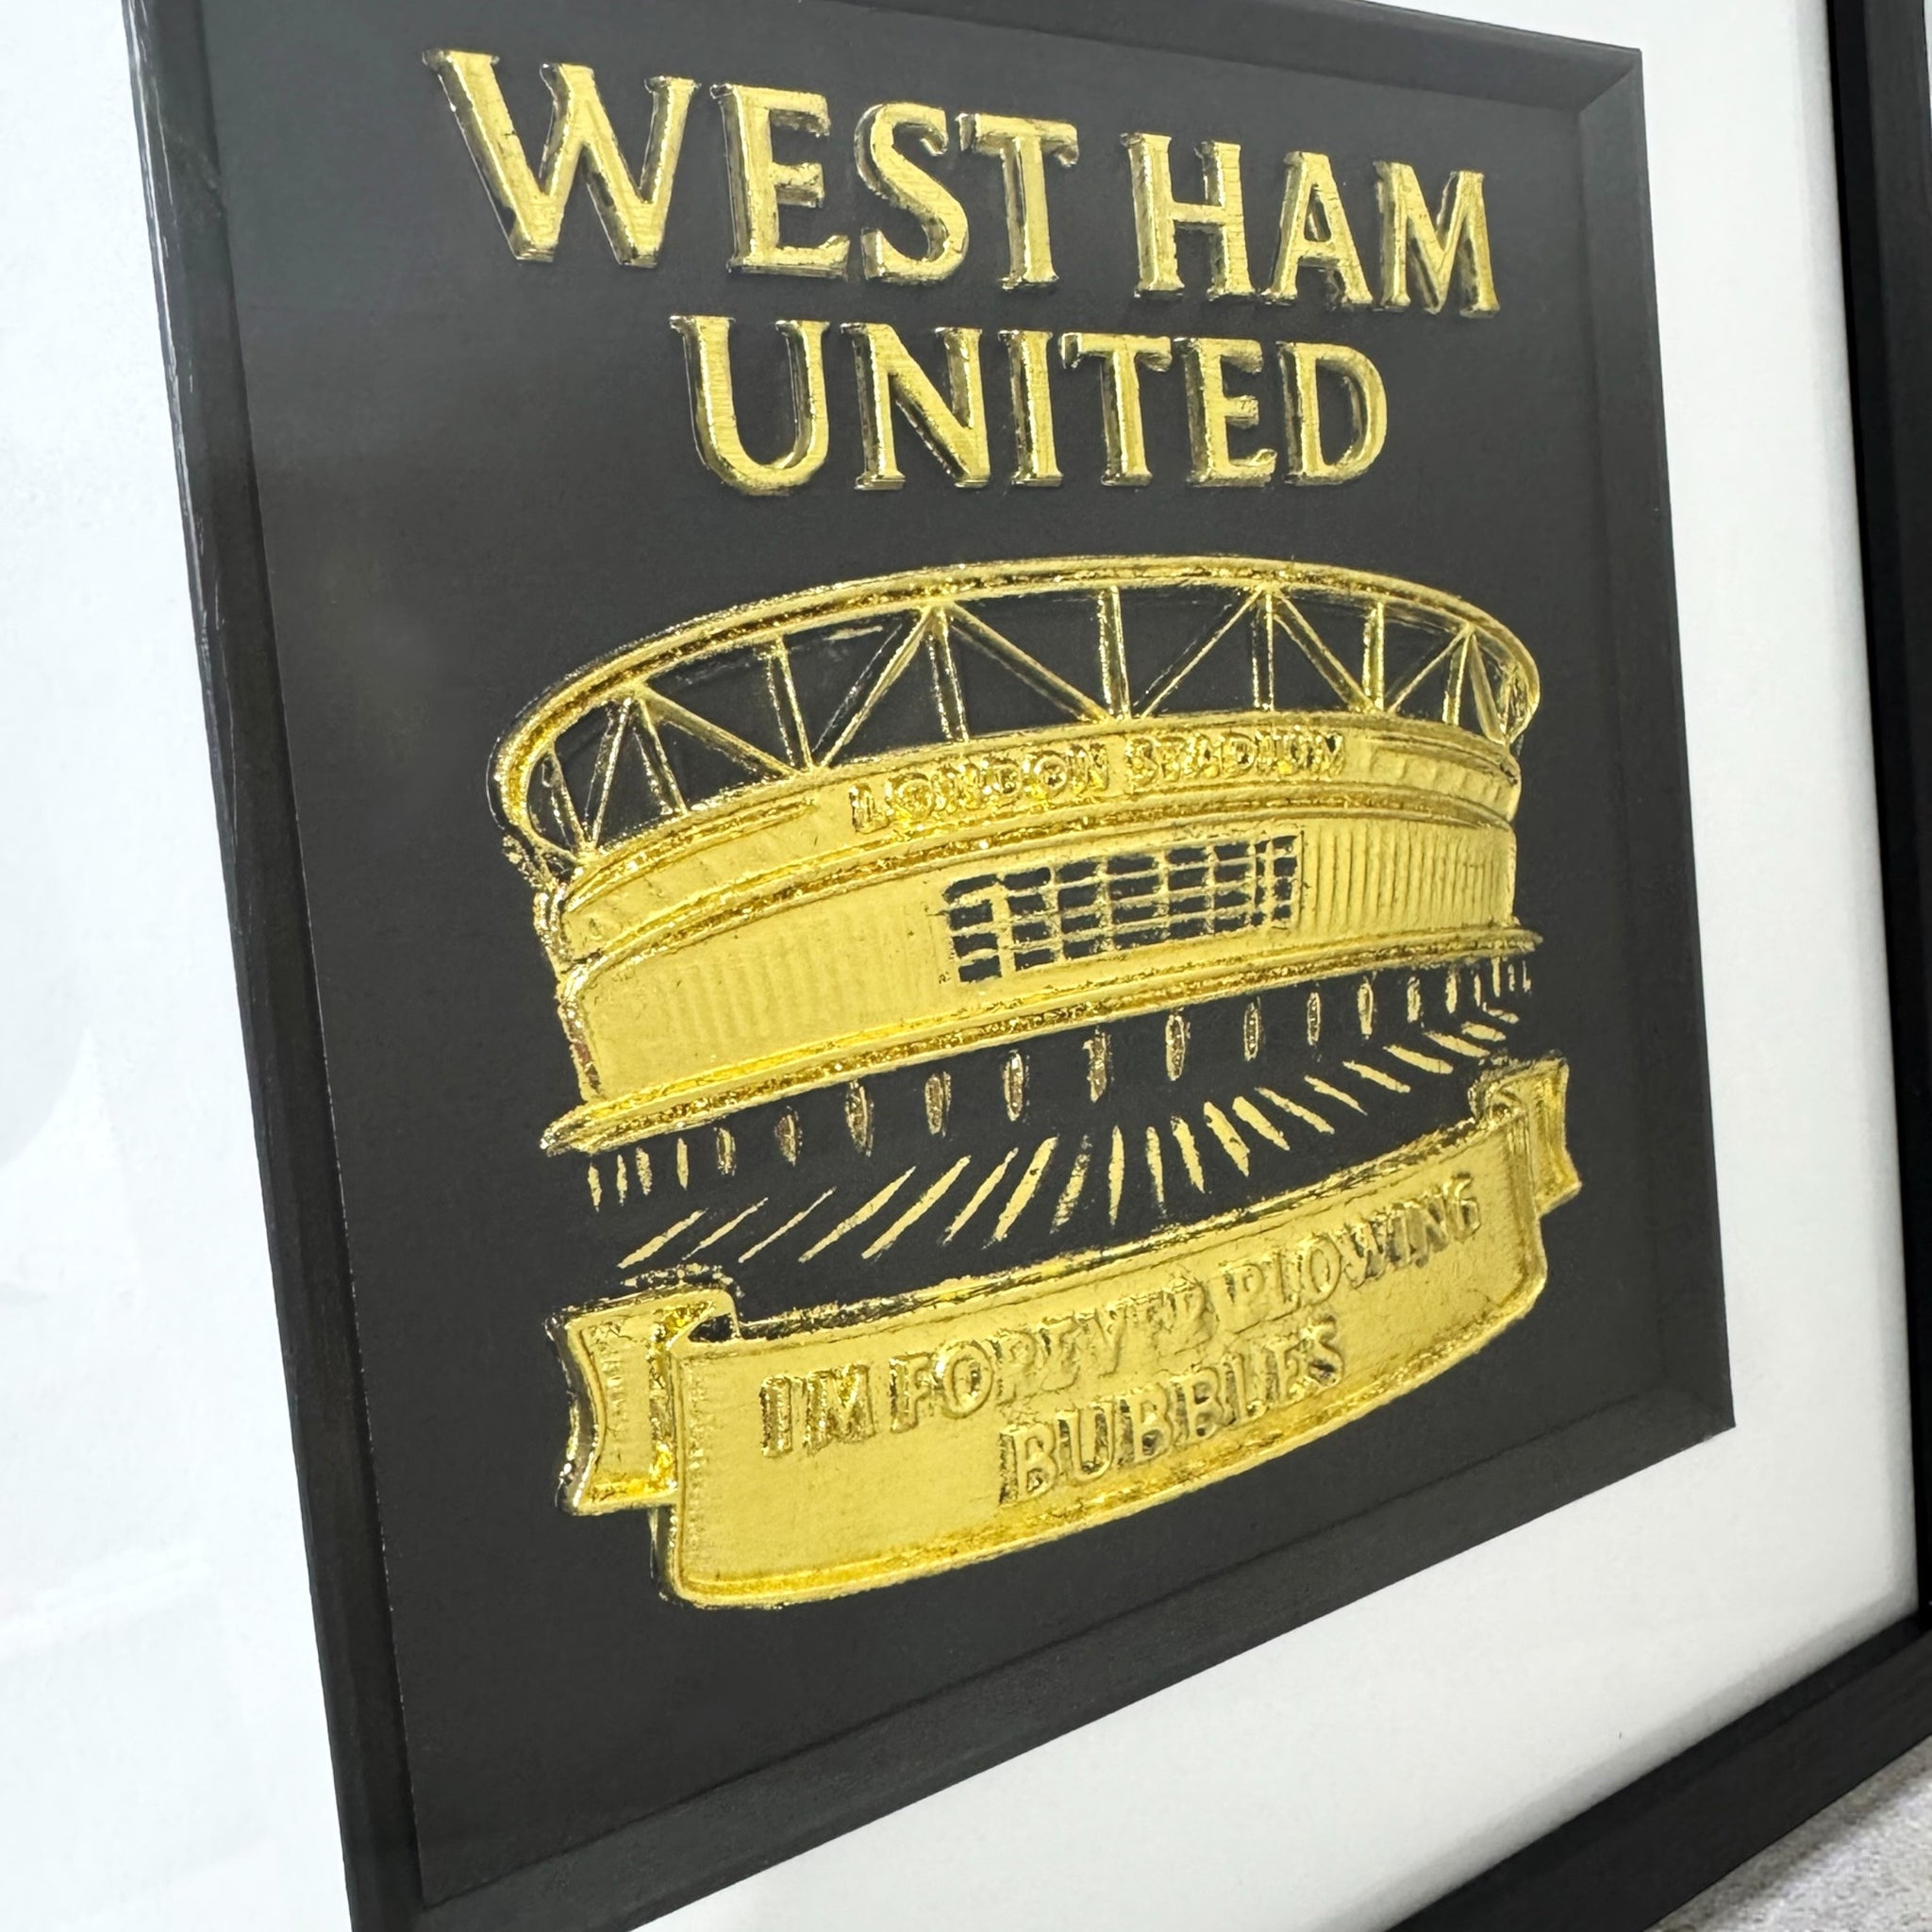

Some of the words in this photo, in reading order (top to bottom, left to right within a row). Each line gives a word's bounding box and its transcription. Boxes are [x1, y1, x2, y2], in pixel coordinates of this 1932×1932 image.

[422, 51, 1079, 290] WEST
[1121, 131, 1498, 317] HAM
[669, 314, 1389, 496] UNITED
[849, 743, 1110, 834] LONDON
[1124, 728, 1346, 791] STADIUM
